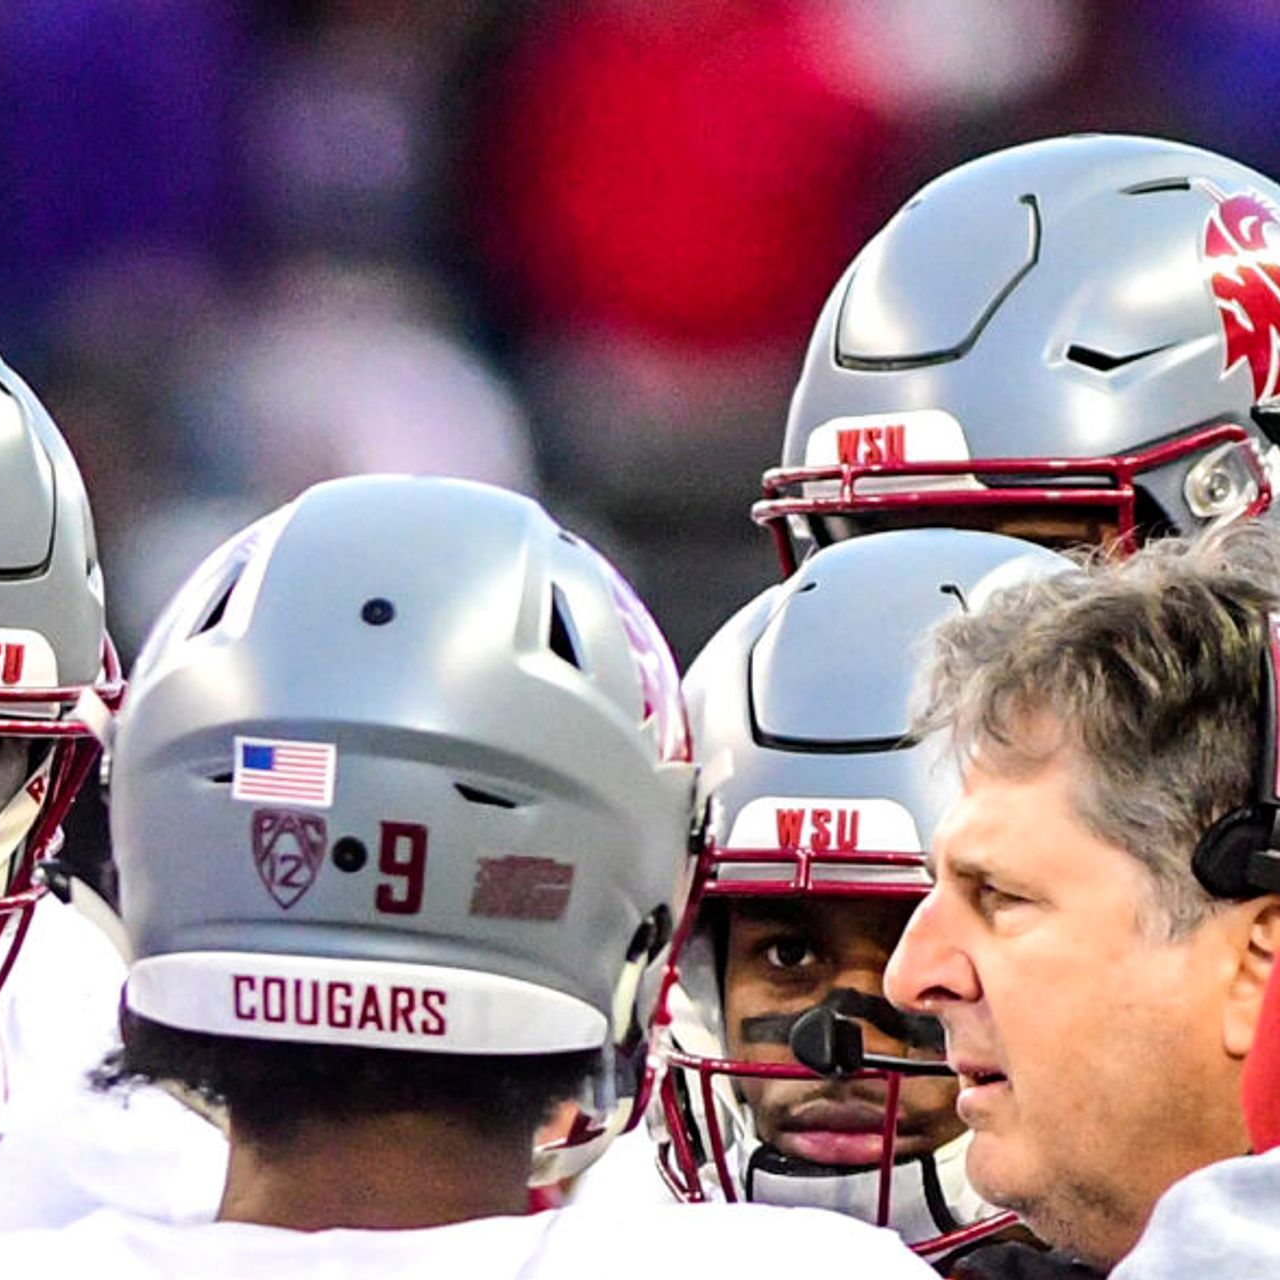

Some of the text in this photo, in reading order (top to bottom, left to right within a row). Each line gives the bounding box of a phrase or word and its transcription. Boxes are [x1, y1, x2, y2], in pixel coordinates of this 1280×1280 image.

[836, 424, 906, 467] WSU
[776, 808, 860, 850] WSU
[375, 820, 428, 915] 9
[232, 974, 447, 1036] COUGARS
